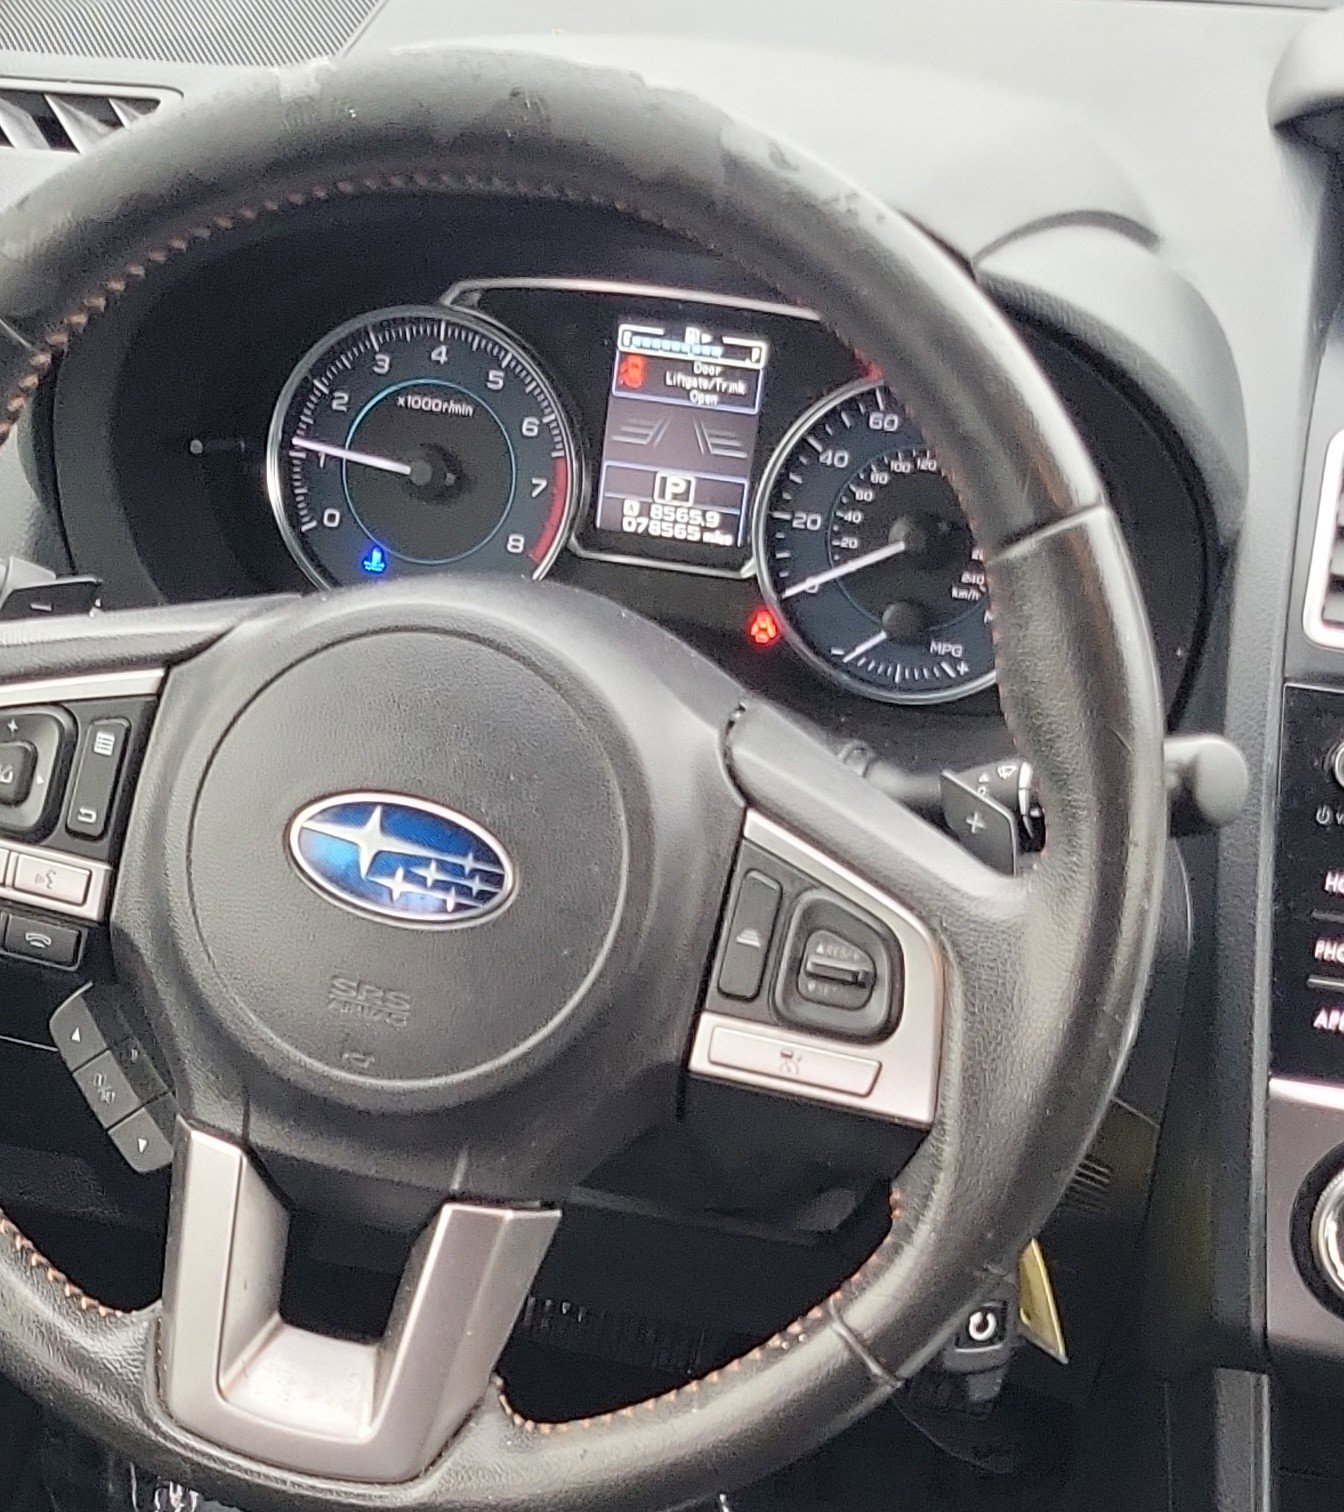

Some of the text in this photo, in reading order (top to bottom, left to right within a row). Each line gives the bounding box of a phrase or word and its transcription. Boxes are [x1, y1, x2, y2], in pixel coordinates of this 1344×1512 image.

[373, 354, 391, 375] 3
[430, 345, 448, 365] 4
[693, 360, 723, 377] Door
[486, 370, 505, 390] 5
[331, 391, 350, 412] 2
[689, 388, 719, 406] Open
[521, 417, 540, 437] 6
[868, 412, 899, 432] 60
[819, 450, 849, 468] 40
[531, 478, 548, 498] 7
[664, 478, 688, 502] P
[322, 507, 341, 529] 0
[792, 512, 823, 531] 20
[622, 516, 701, 542] 078565
[506, 533, 525, 554] 8
[929, 640, 964, 659] MPG
